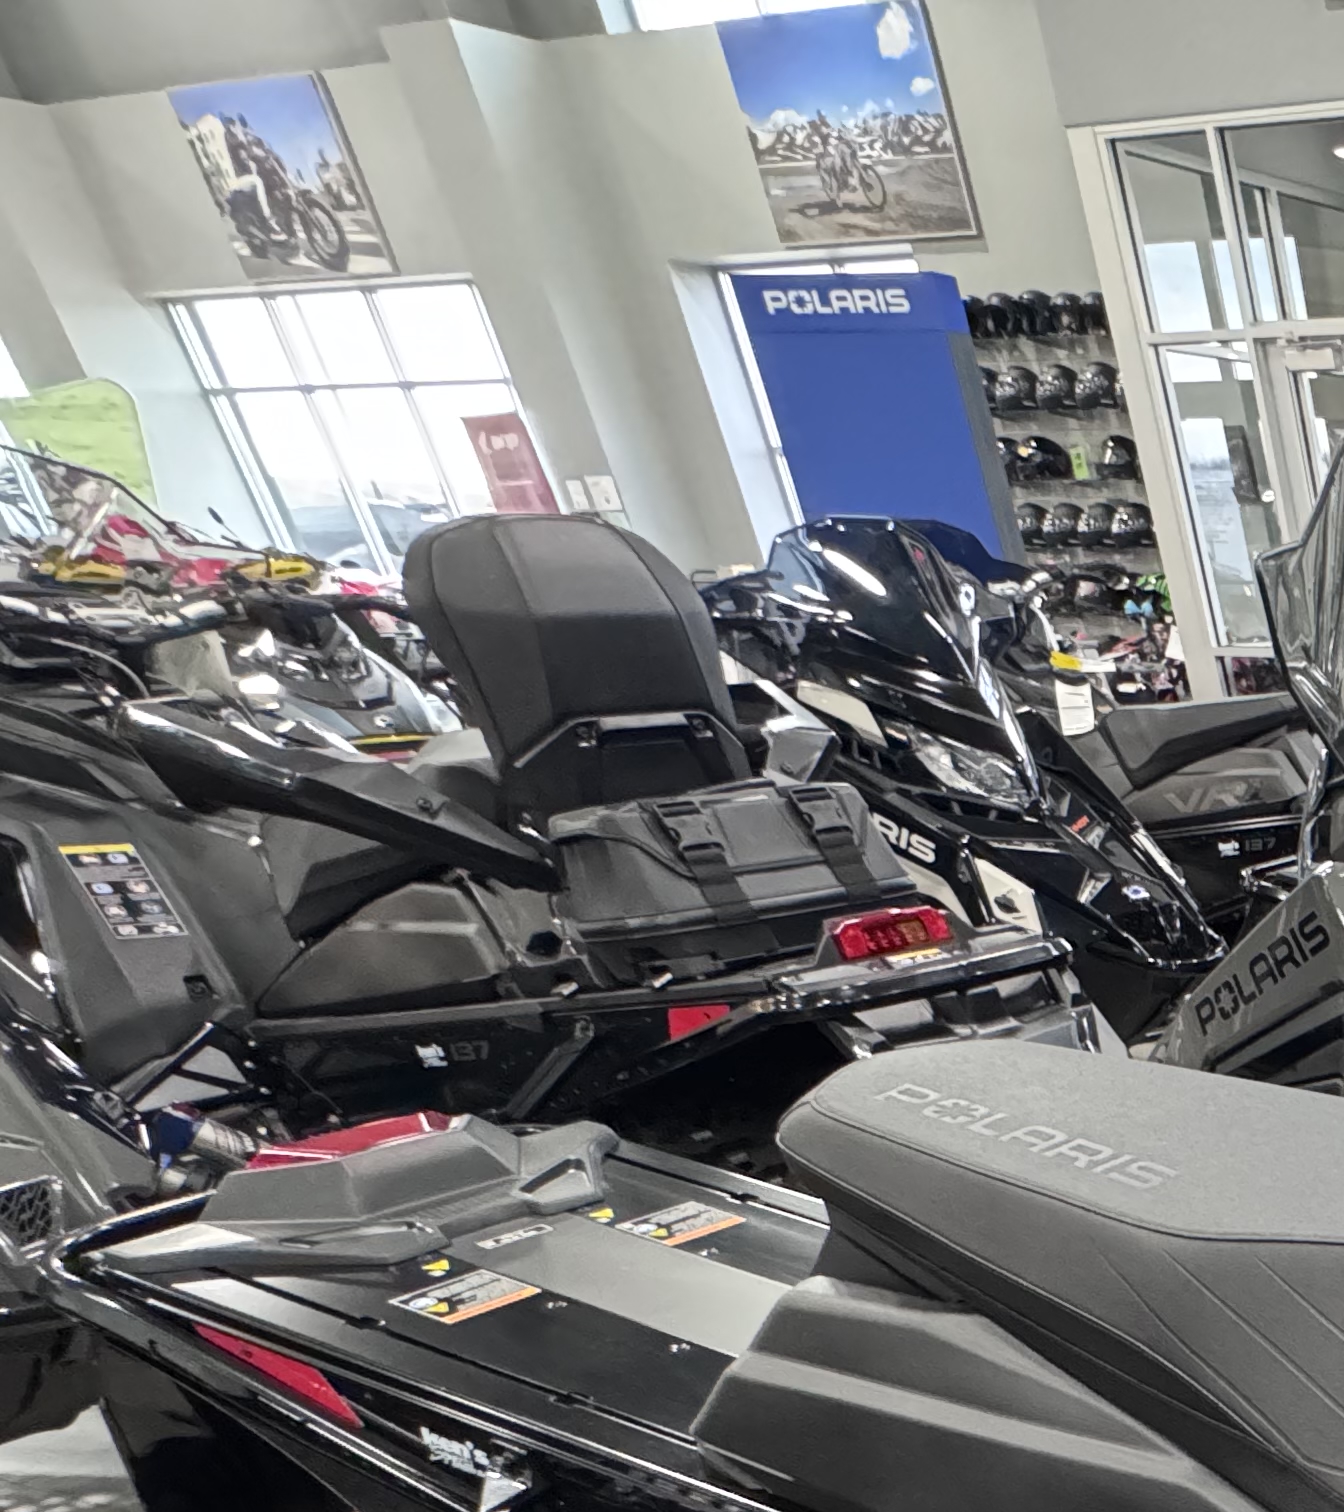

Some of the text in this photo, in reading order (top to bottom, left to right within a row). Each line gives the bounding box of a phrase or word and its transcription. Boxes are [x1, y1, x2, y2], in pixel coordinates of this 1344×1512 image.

[762, 288, 911, 315] POLARIS
[1195, 912, 1331, 1035] POLARIS
[874, 1083, 1183, 1192] POLARIS
